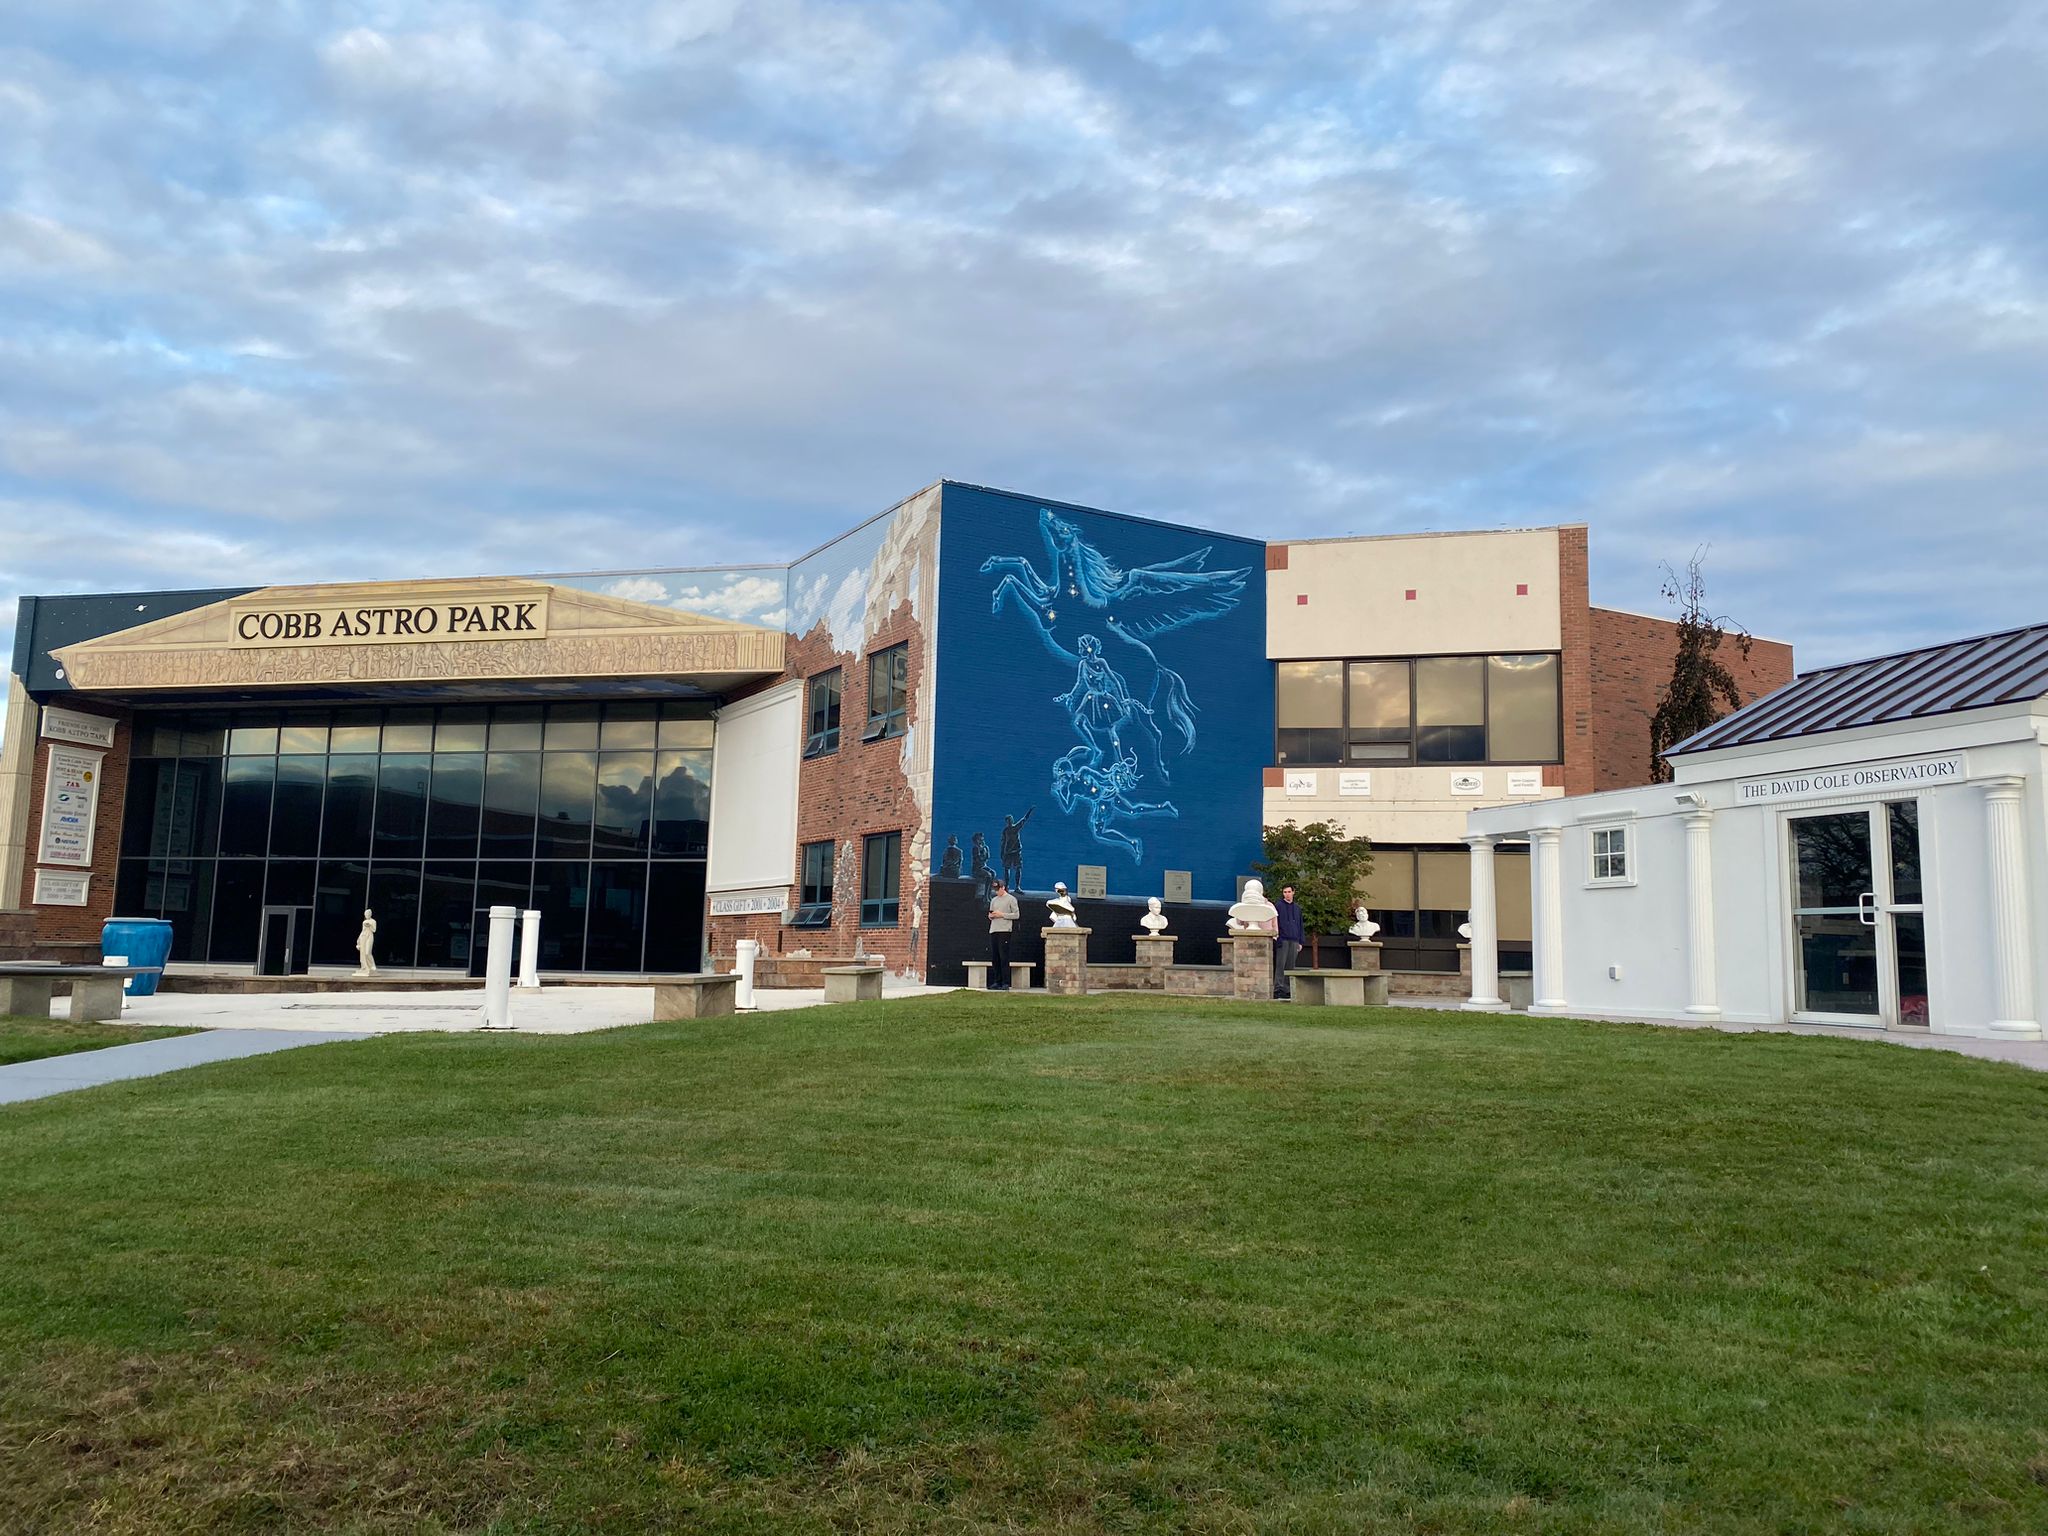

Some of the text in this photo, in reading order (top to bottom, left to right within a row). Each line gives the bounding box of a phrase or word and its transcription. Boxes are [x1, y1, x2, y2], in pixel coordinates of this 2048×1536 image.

[238, 603, 538, 640] COBB ASTRO PARK
[1742, 761, 1959, 798] THE DAVID COLE OBSERVATORY
[716, 896, 780, 913] CLASS GIFT 2001 2004
